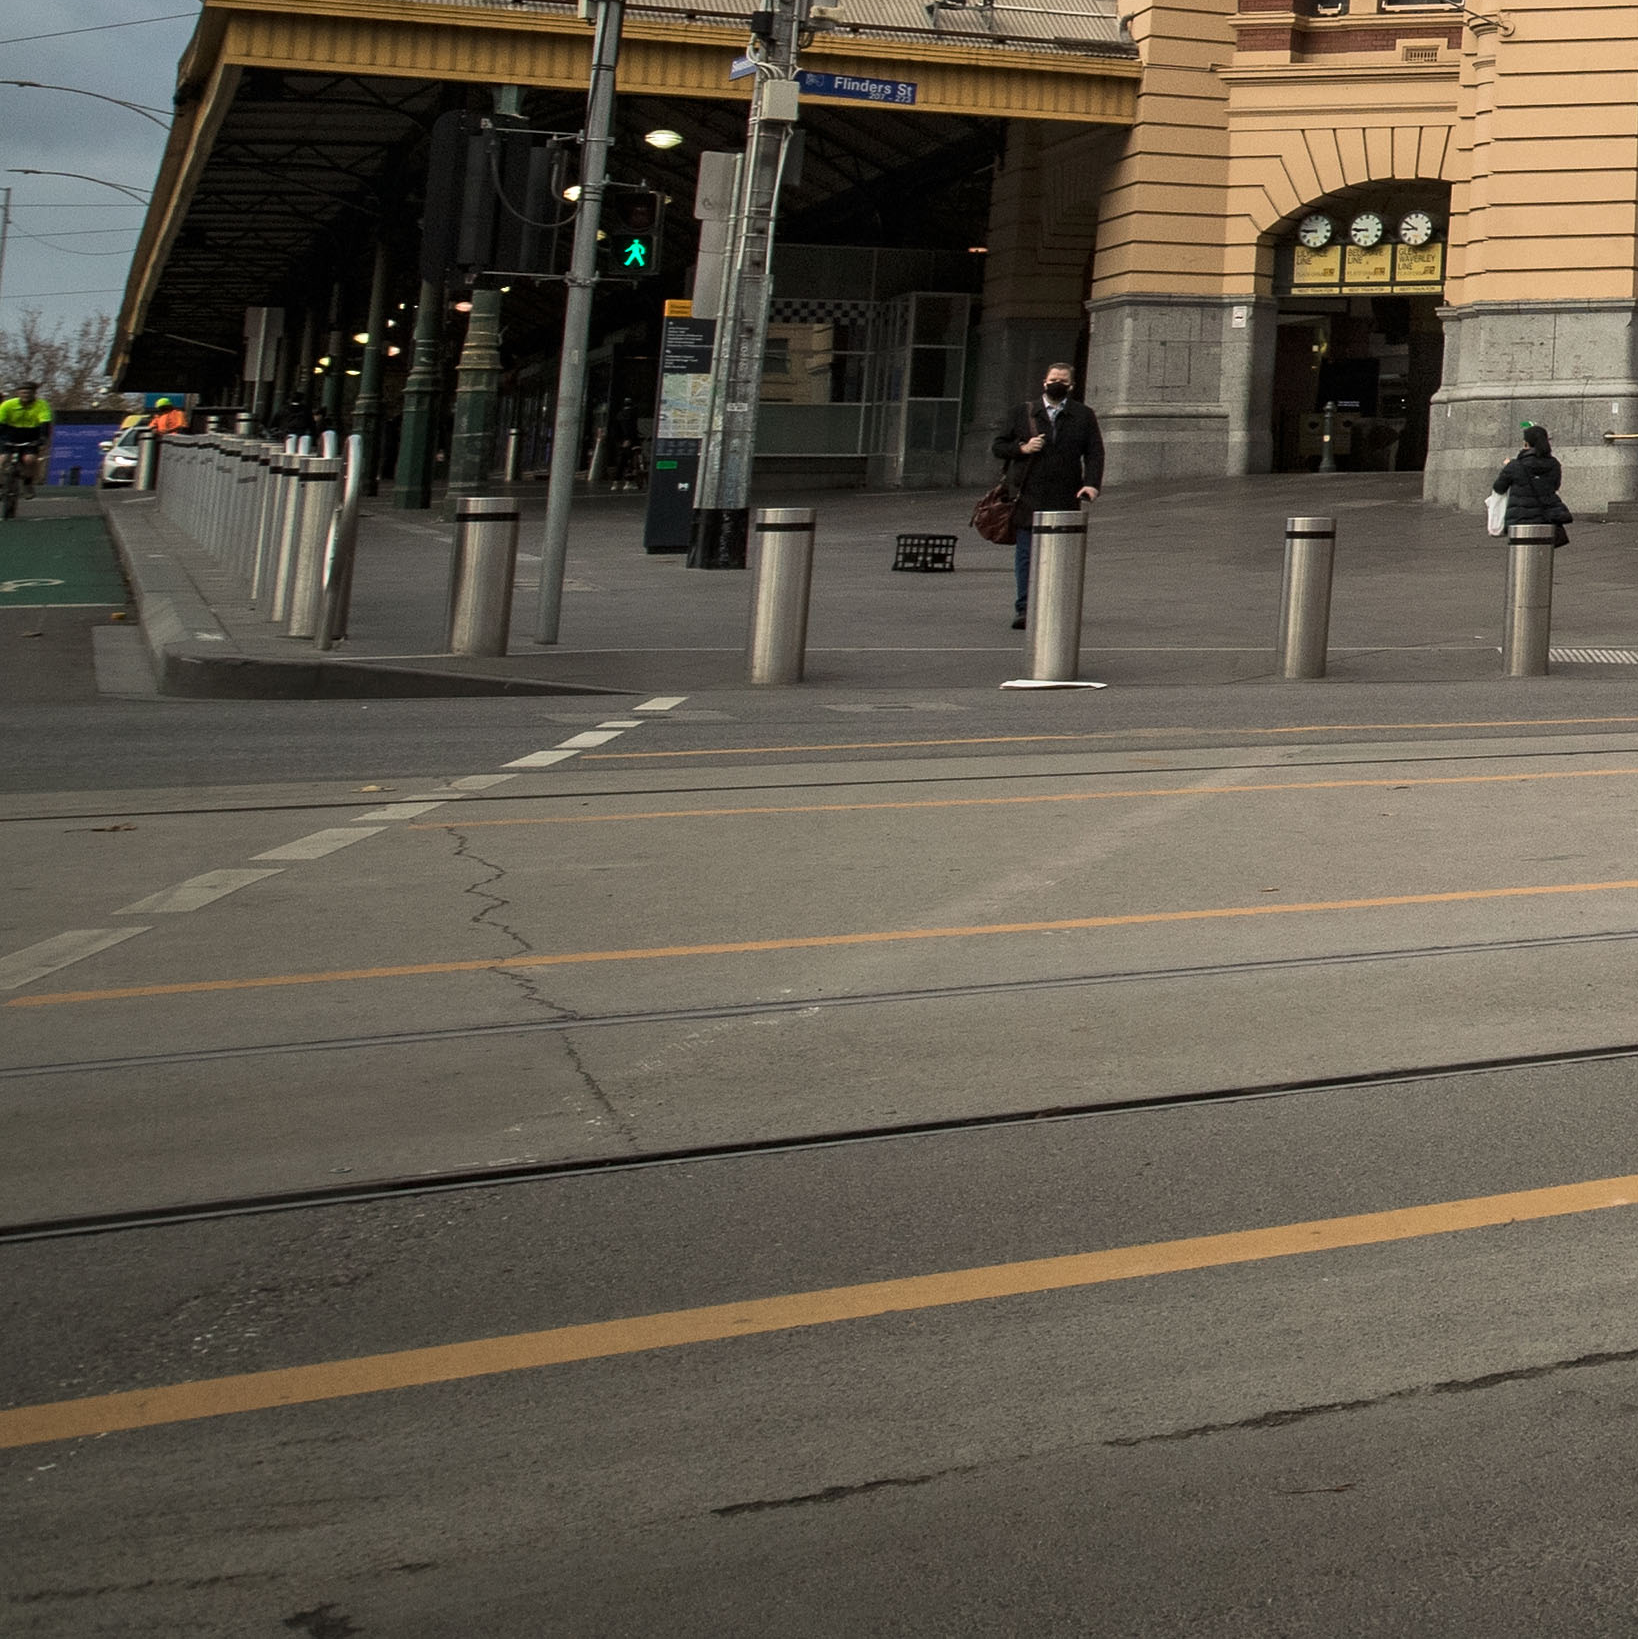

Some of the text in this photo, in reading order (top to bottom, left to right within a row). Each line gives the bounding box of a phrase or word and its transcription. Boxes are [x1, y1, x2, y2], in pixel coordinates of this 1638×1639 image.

[834, 77, 912, 97] Flinders St
[1399, 248, 1418, 257] GLEN
[1347, 256, 1363, 265] LINE
[1399, 254, 1436, 263] WAVERLEY
[1398, 262, 1413, 271] LINE
